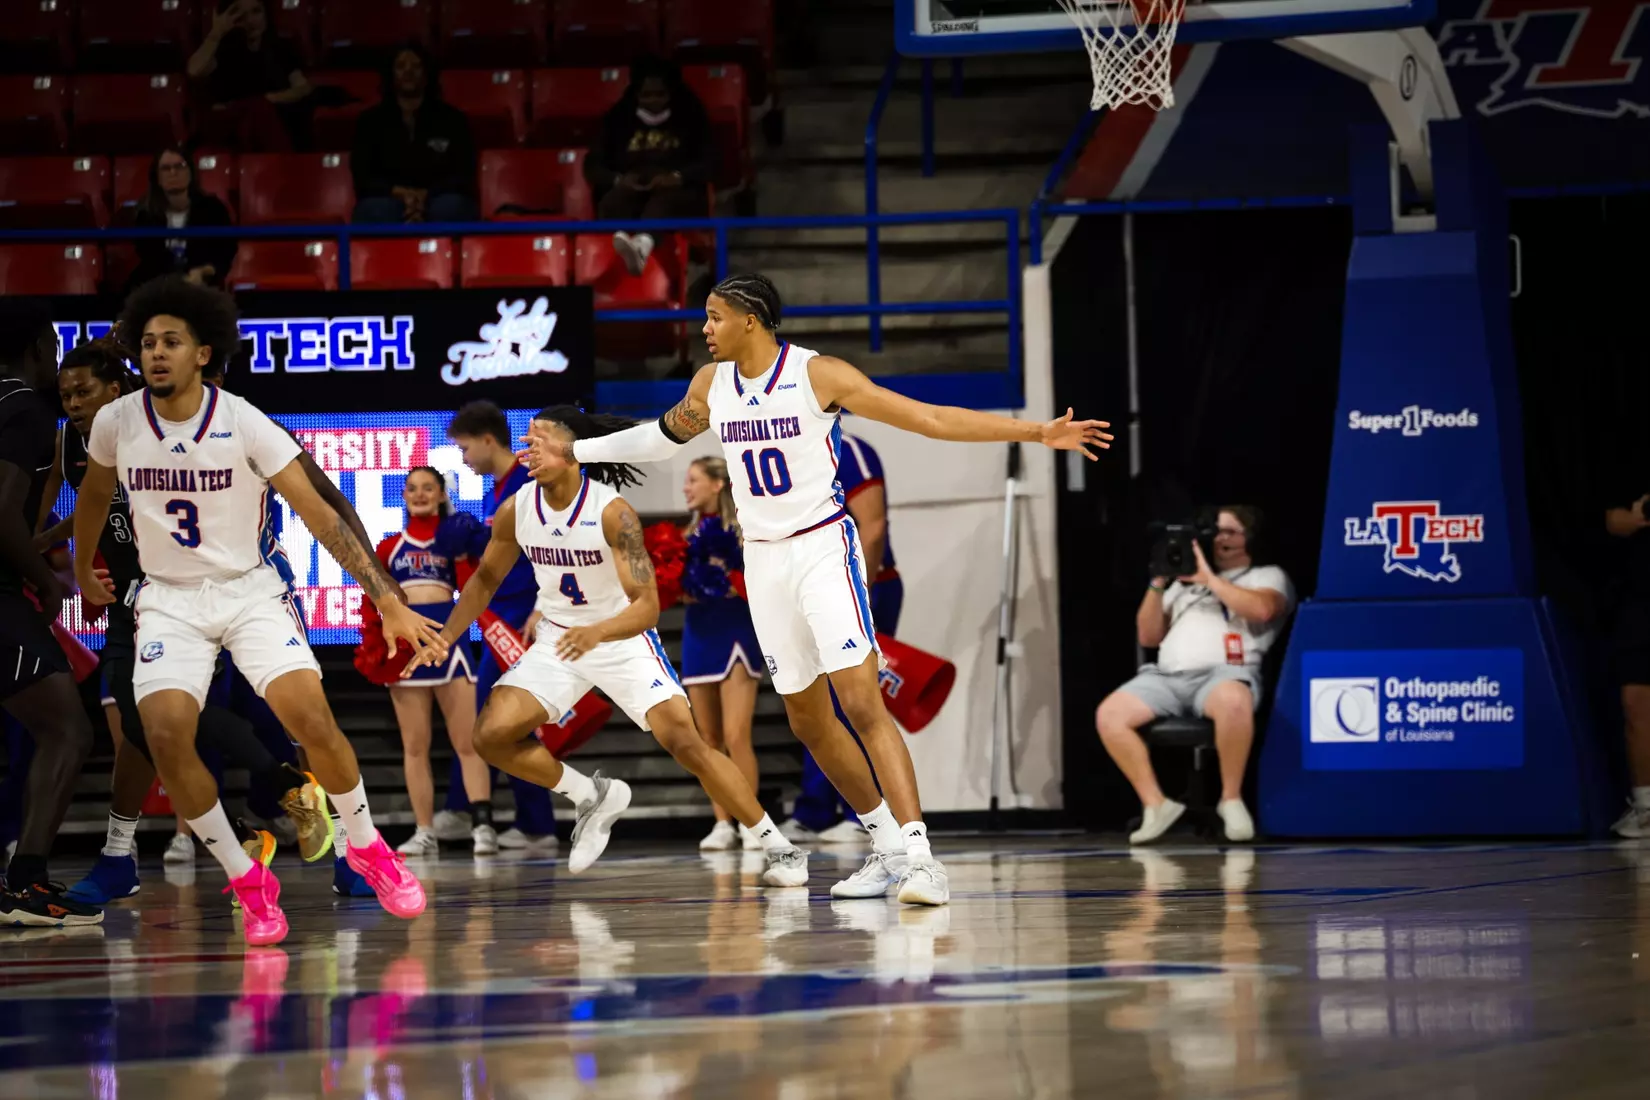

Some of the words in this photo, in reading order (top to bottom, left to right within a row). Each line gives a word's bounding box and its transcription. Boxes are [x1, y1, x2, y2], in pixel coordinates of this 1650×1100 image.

[237, 316, 415, 374] TECH
[720, 418, 771, 444] LOUISIANA
[770, 416, 802, 440] TECH
[1349, 410, 1402, 433] Super
[1421, 408, 1478, 429] Foods
[128, 467, 197, 492] LOUISIANA
[199, 467, 233, 490] TECH
[741, 447, 792, 497] 10
[165, 499, 201, 549] 3
[1345, 517, 1390, 545] LA
[525, 544, 577, 567] LOUISIANA
[575, 548, 604, 566] TECH
[559, 573, 588, 606] 4
[1385, 676, 1500, 702] Orthopaedic
[1385, 702, 1402, 724] &
[1406, 702, 1458, 728] Spine
[1461, 701, 1514, 723] Clinic
[1385, 728, 1398, 742] of
[1400, 727, 1454, 742] Louisiana
